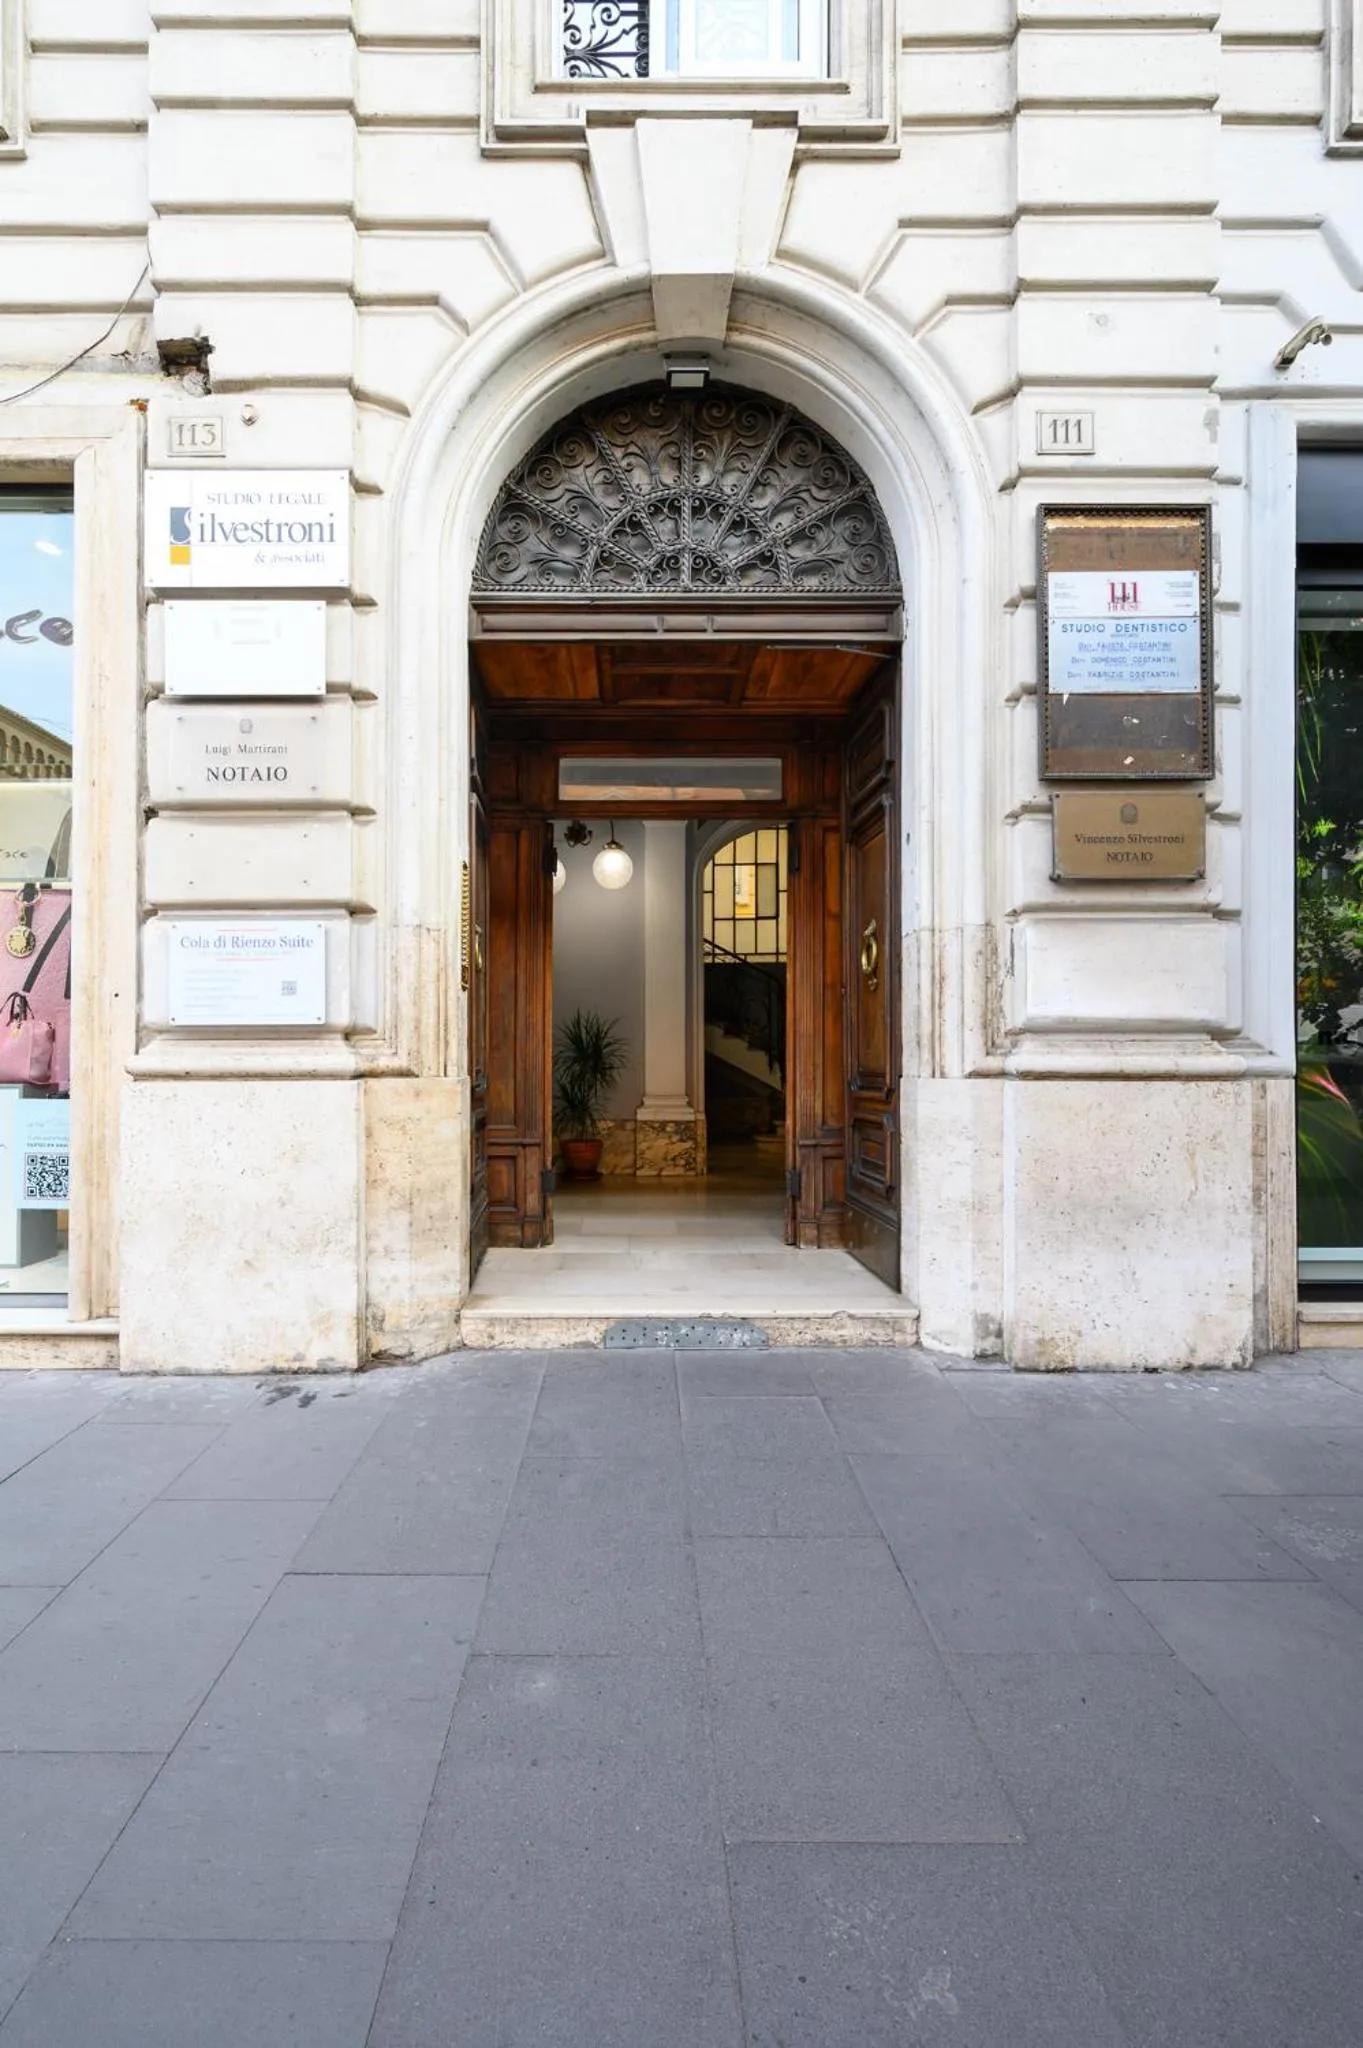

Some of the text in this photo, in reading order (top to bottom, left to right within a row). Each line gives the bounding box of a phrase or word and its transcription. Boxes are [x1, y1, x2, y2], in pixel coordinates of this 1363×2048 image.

[177, 424, 217, 446] 113
[1049, 418, 1083, 444] 111
[207, 492, 325, 505] STUDIO LEGALE
[170, 507, 336, 544] Silvestroni
[253, 550, 266, 563] &
[1061, 622, 1188, 634] STUDIO DENTISTICO
[1091, 656, 1127, 664] DOMENICO
[1132, 656, 1177, 664] COSTANTINI
[1087, 671, 1124, 679] FABRIZIO
[1129, 671, 1180, 679] COSTANTINI
[205, 744, 231, 756] Luigi
[206, 766, 288, 781] NOTAIO
[1074, 833, 1185, 845] Vincenzo Silvestroni
[1106, 851, 1153, 863] NOTAIO
[180, 935, 314, 949] Cola di Rienzo Suite
